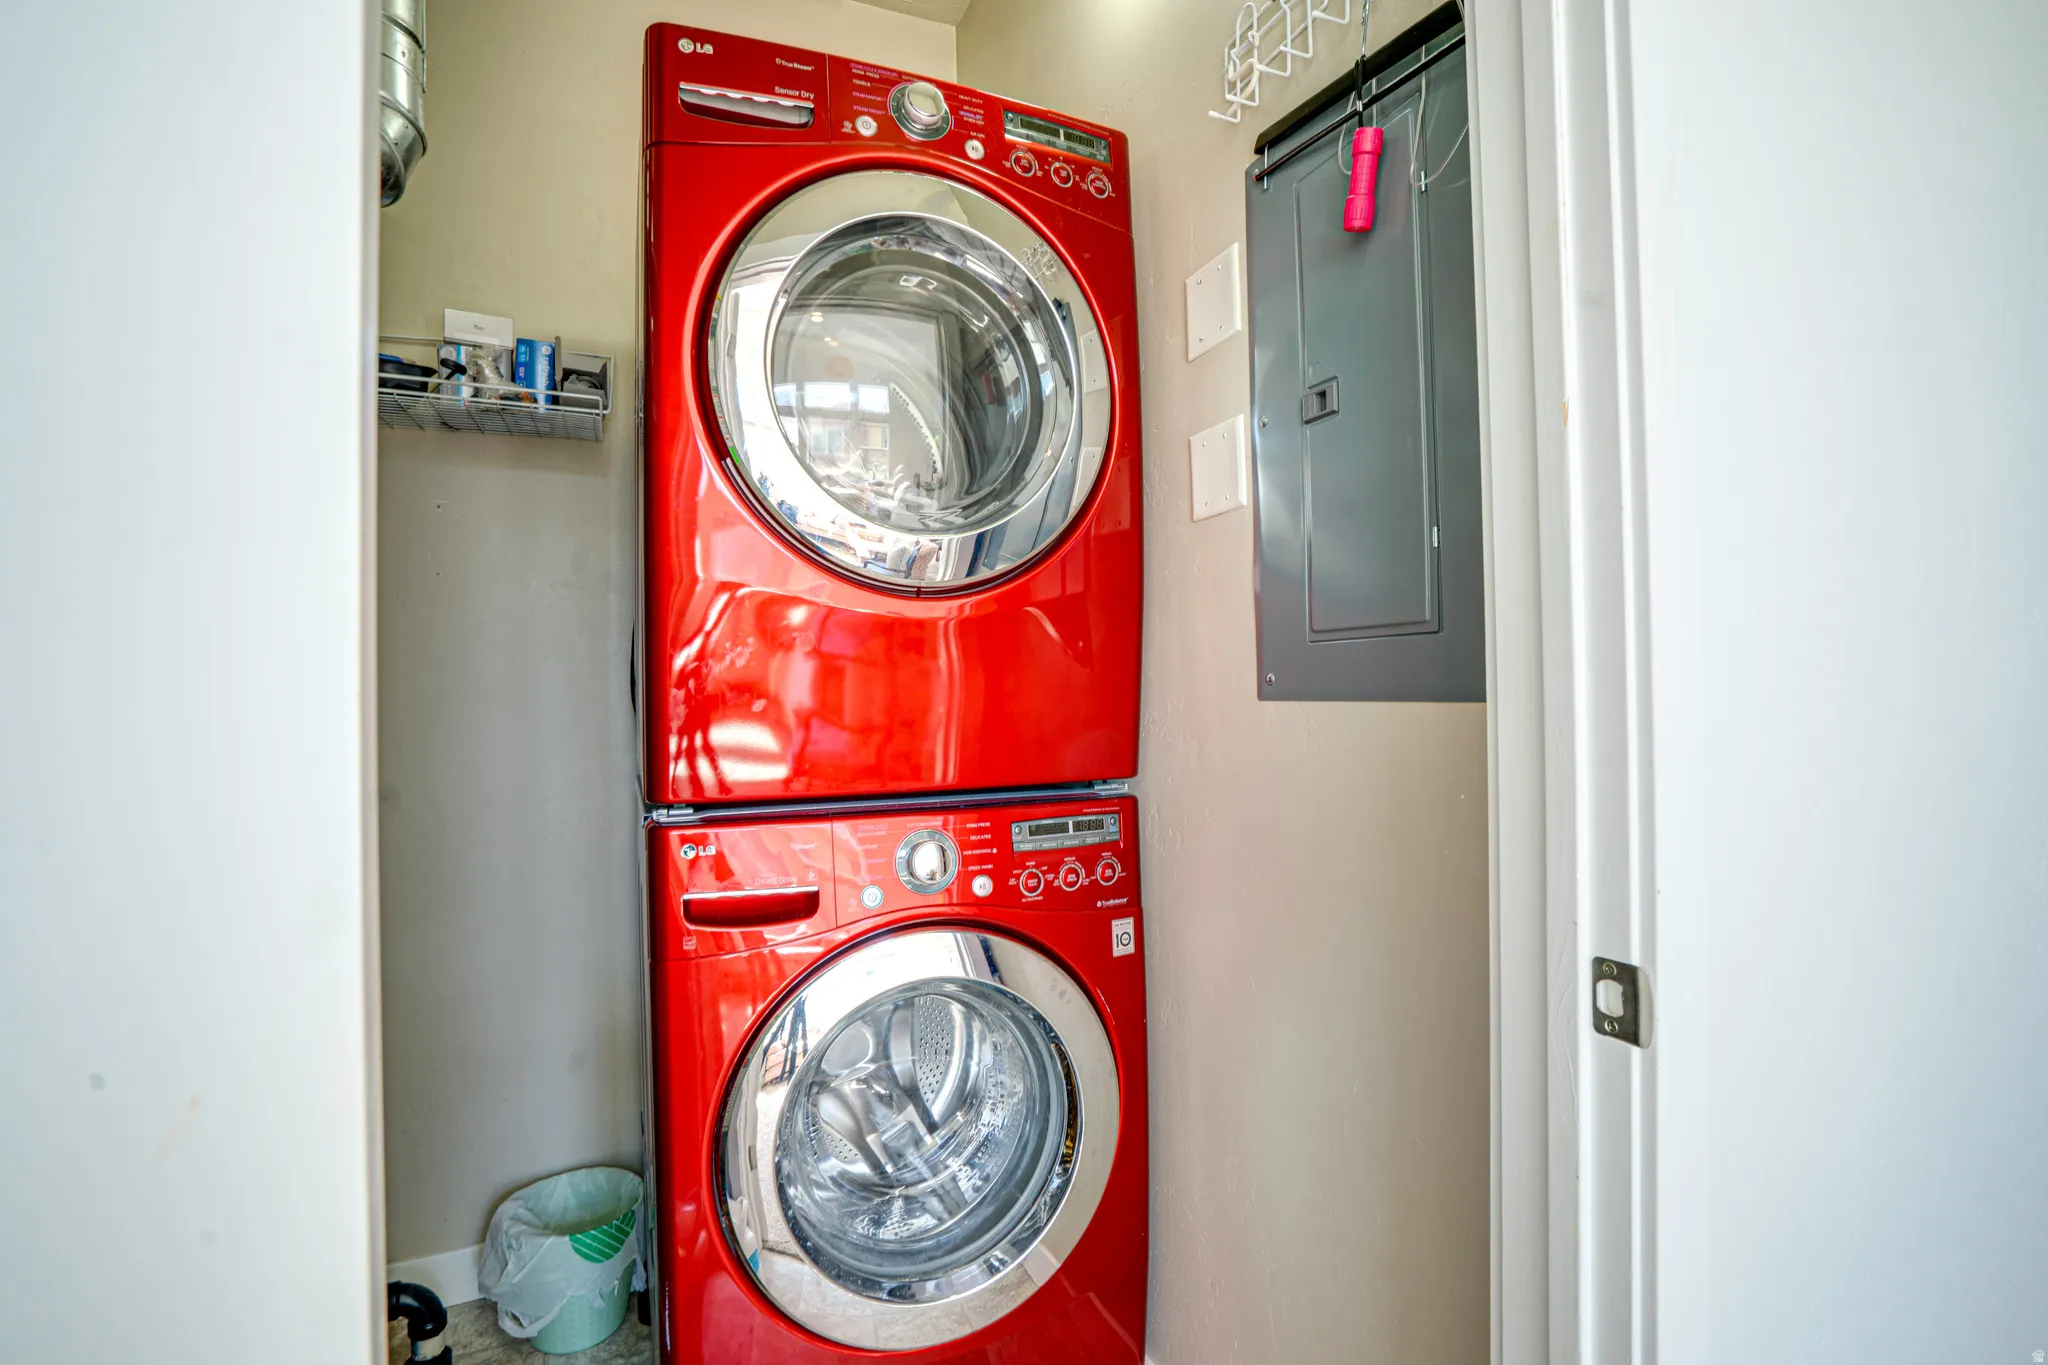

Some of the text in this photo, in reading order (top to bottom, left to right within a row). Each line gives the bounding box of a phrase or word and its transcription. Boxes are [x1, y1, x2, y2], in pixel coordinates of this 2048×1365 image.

[695, 42, 714, 54] LG
[774, 86, 815, 100] Sensor Dry
[698, 844, 716, 856] LG
[1115, 931, 1132, 948] 10
